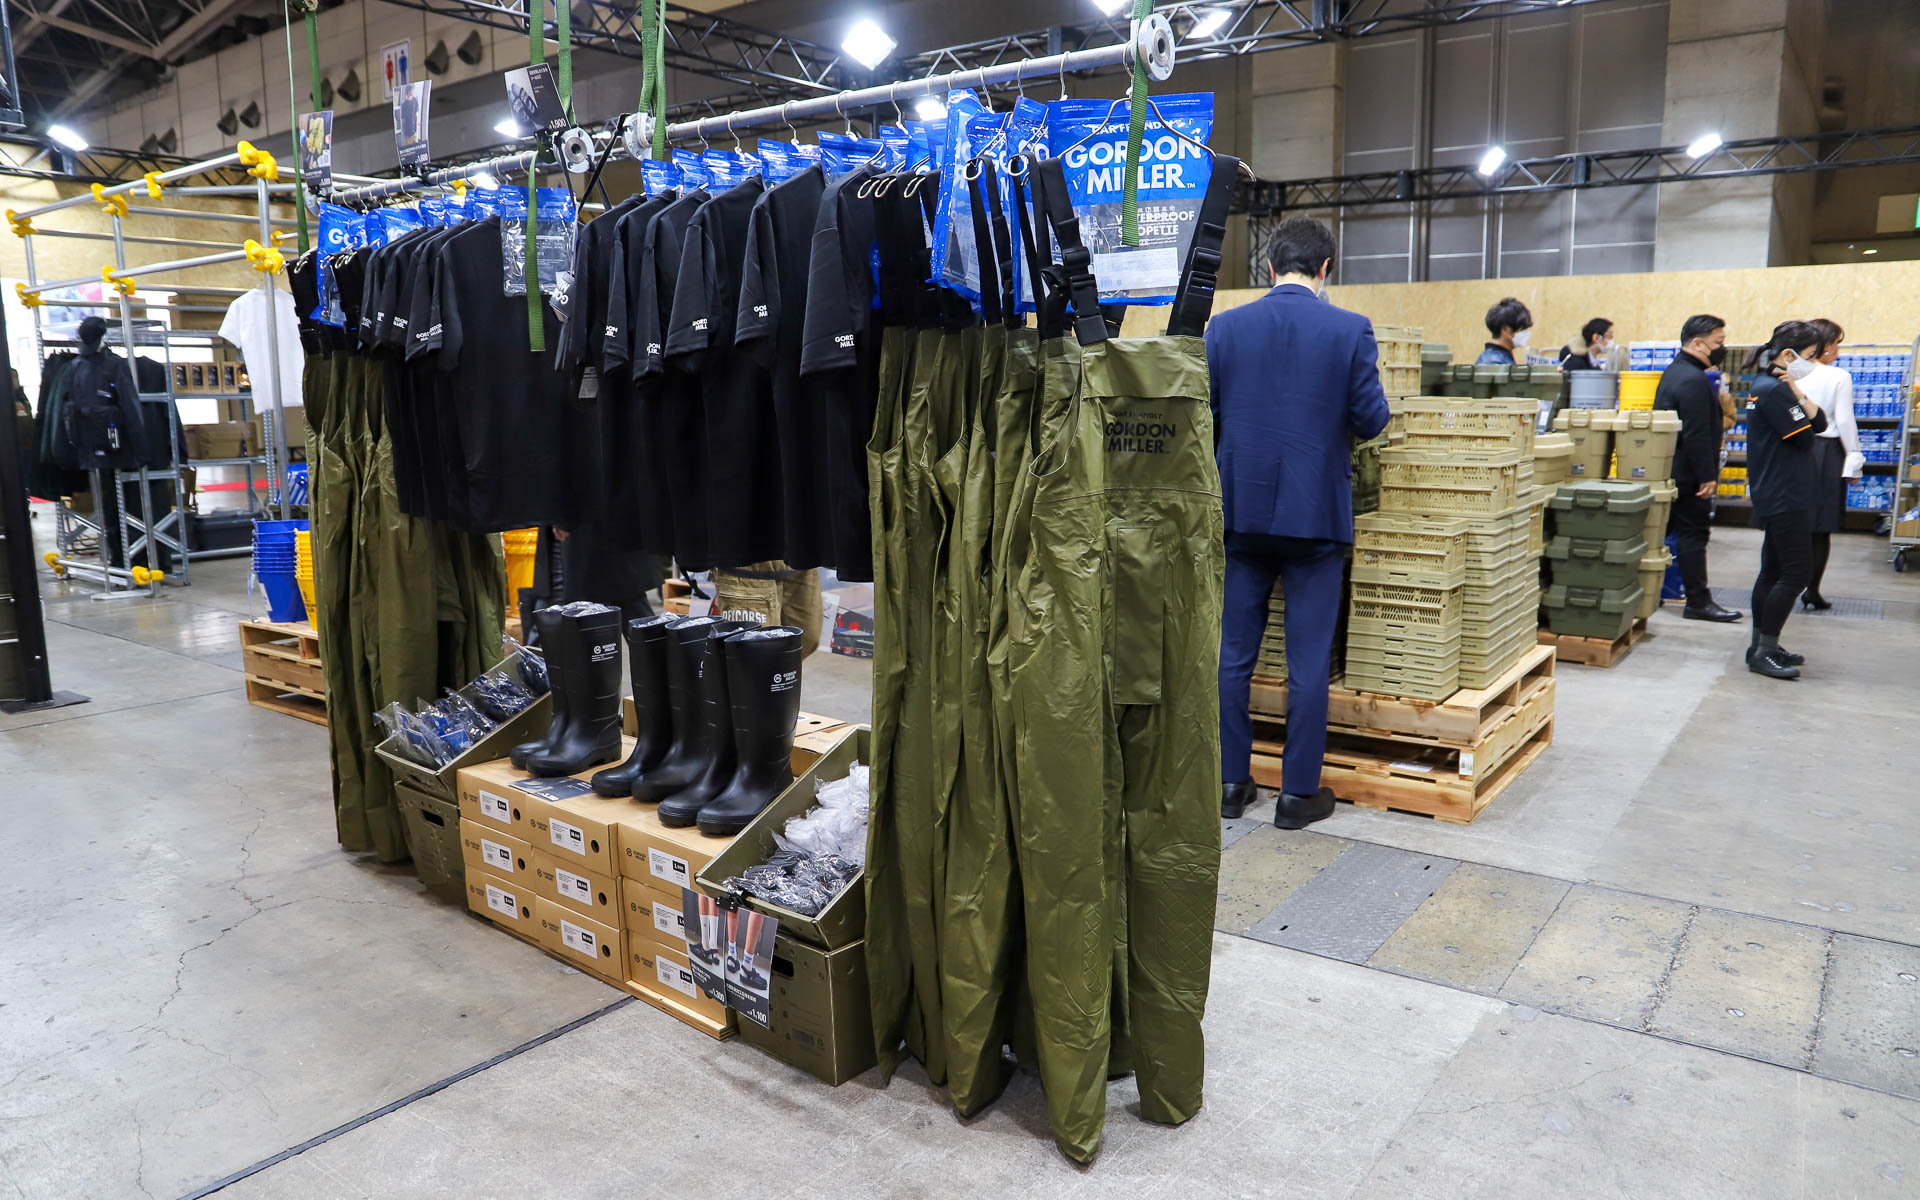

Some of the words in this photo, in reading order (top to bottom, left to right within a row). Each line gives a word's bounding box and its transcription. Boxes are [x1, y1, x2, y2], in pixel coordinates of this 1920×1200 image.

[1065, 136, 1202, 168] GORDON
[1116, 211, 1195, 225] WTERPROOF
[1118, 225, 1179, 238] SOPETTE
[1105, 421, 1176, 438] GORDON
[1109, 438, 1164, 453] MILLER
